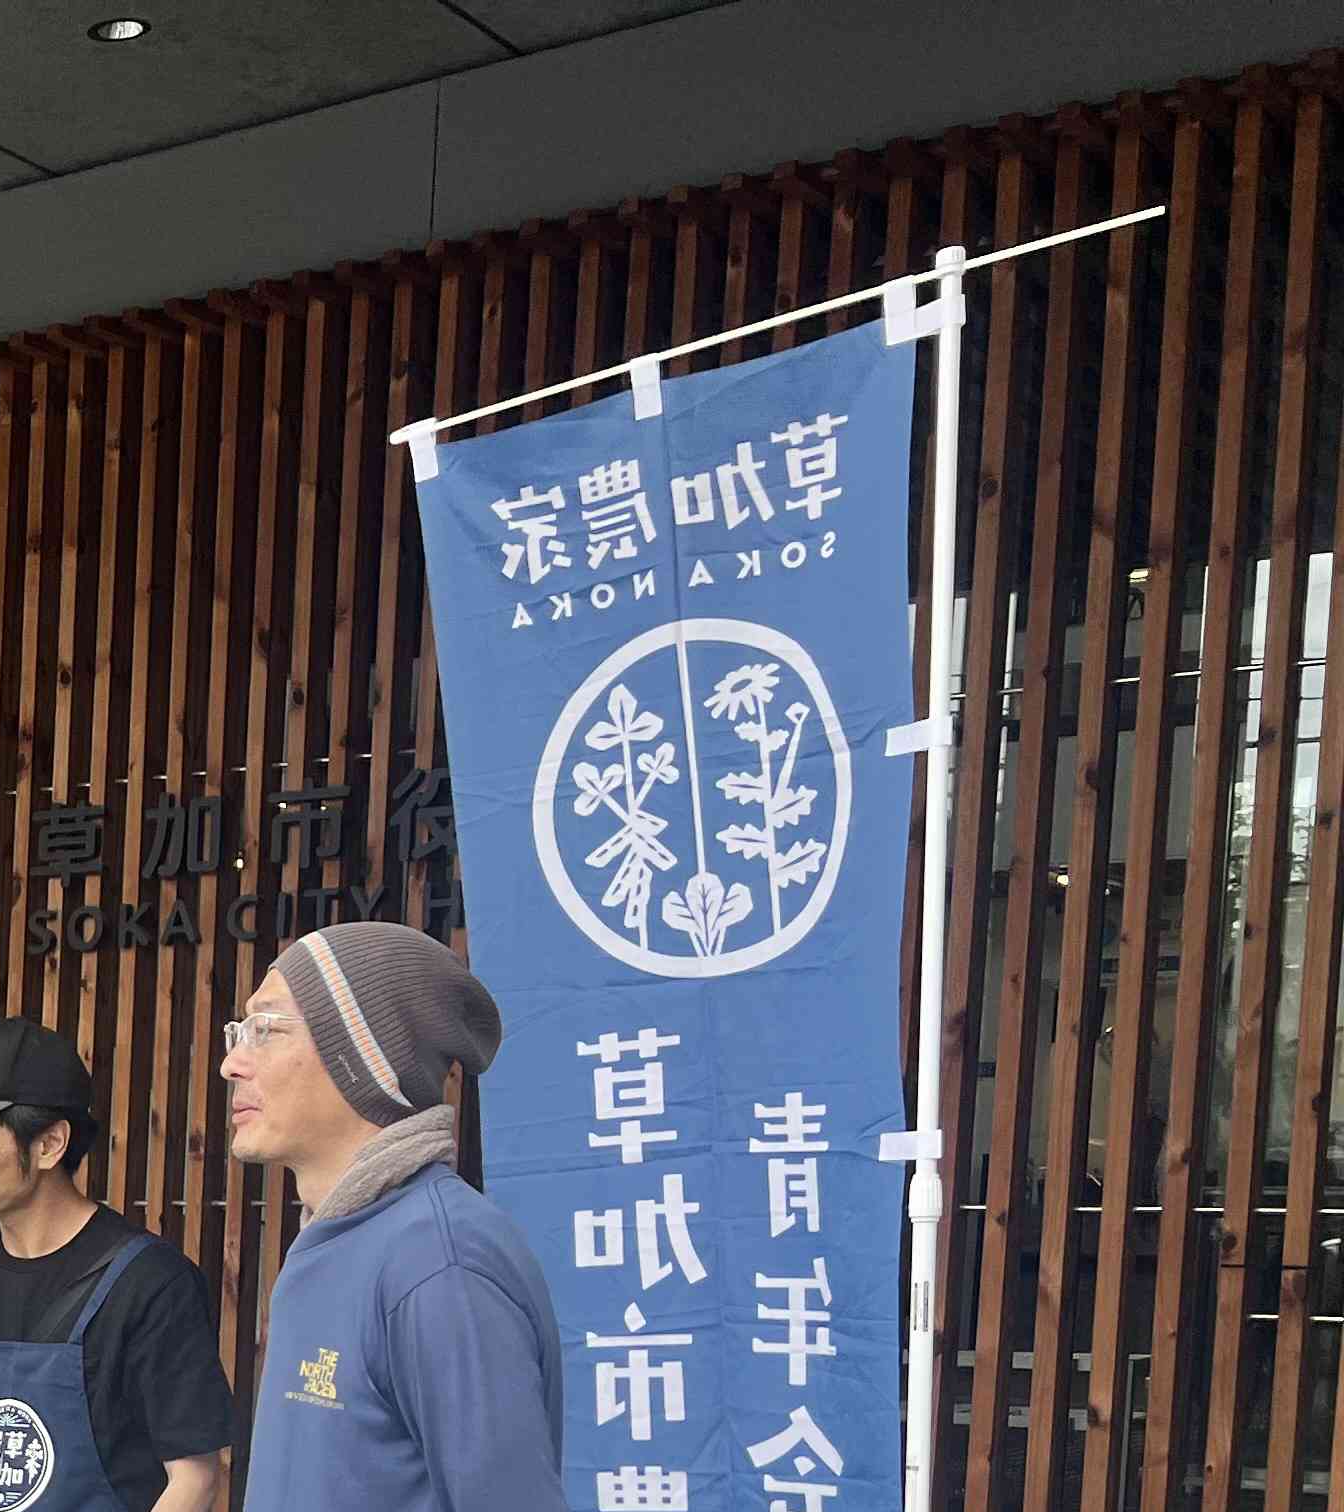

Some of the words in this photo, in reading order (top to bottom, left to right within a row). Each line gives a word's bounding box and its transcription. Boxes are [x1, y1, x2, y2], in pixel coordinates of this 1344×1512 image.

[29, 767, 458, 888] 草加市役
[27, 900, 202, 955] SOKA
[225, 885, 385, 943] CITY
[319, 1347, 339, 1367] THE
[0, 1430, 28, 1487] 草加
